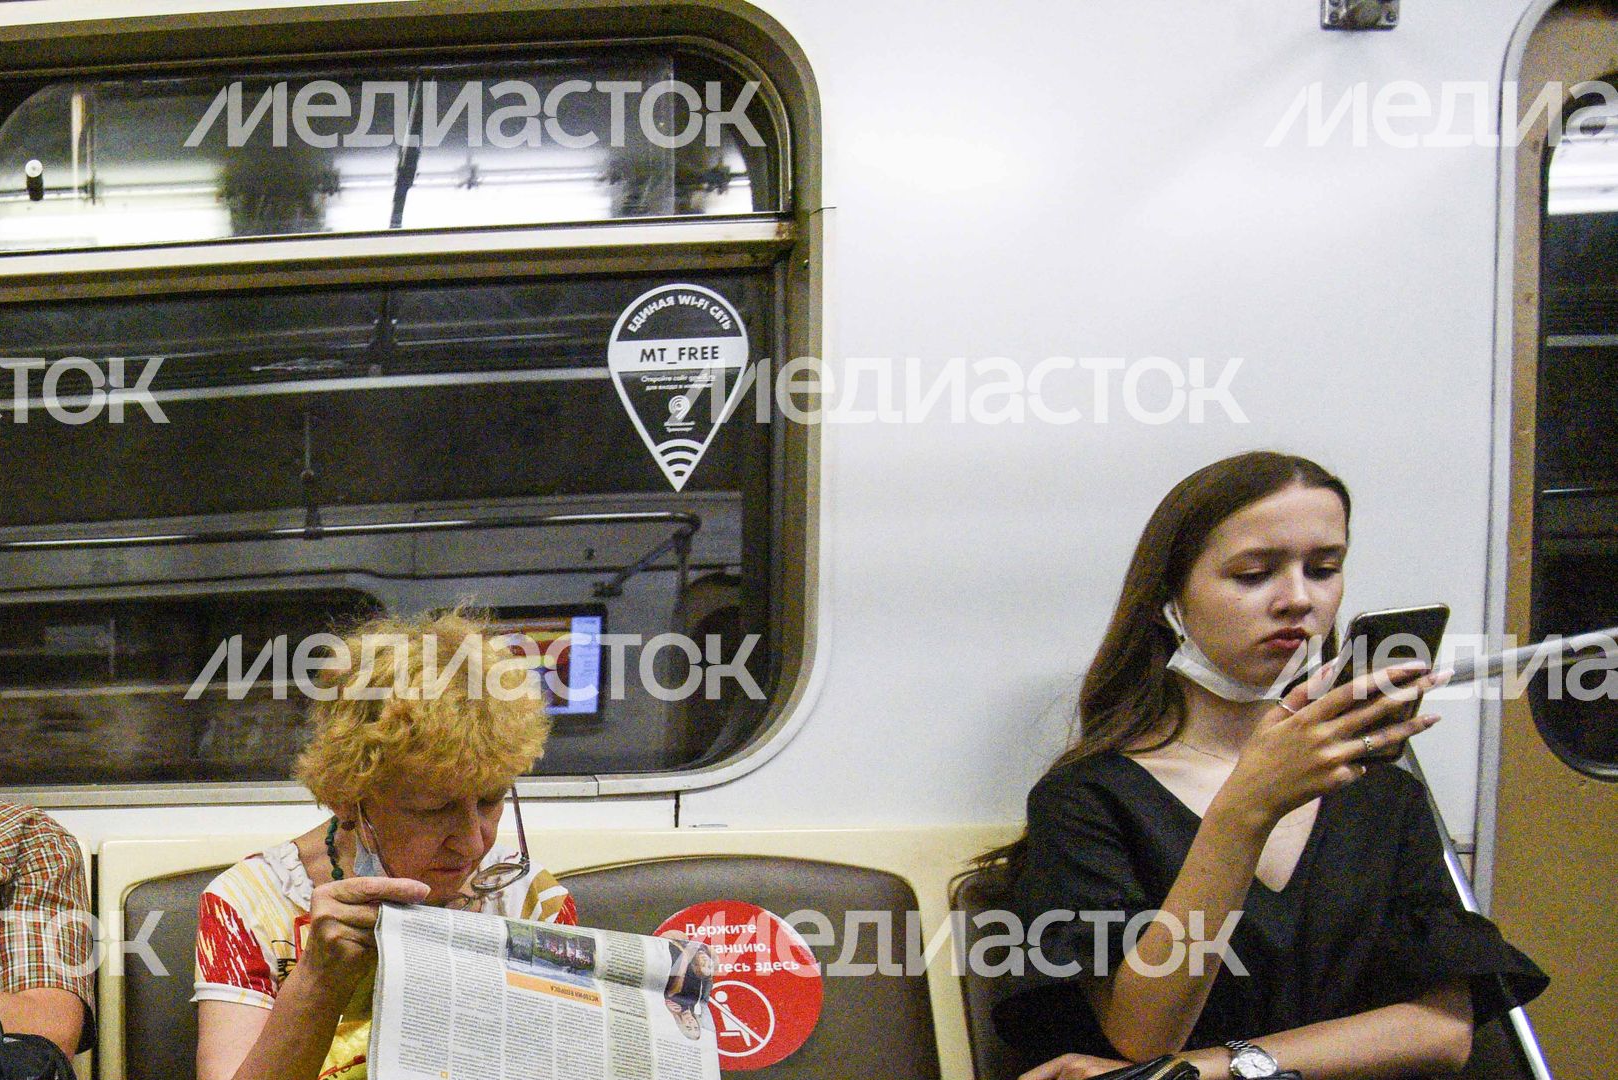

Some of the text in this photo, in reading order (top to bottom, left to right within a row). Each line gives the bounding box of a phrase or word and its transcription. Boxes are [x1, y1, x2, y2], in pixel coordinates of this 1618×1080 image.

[627, 294, 733, 333] ЕДИНАЯ WI-FI СЕТЬ
[640, 345, 720, 364] MT_FREE
[685, 923, 757, 937] Держите
[714, 942, 771, 954] анцию,
[754, 960, 800, 973] здесь
